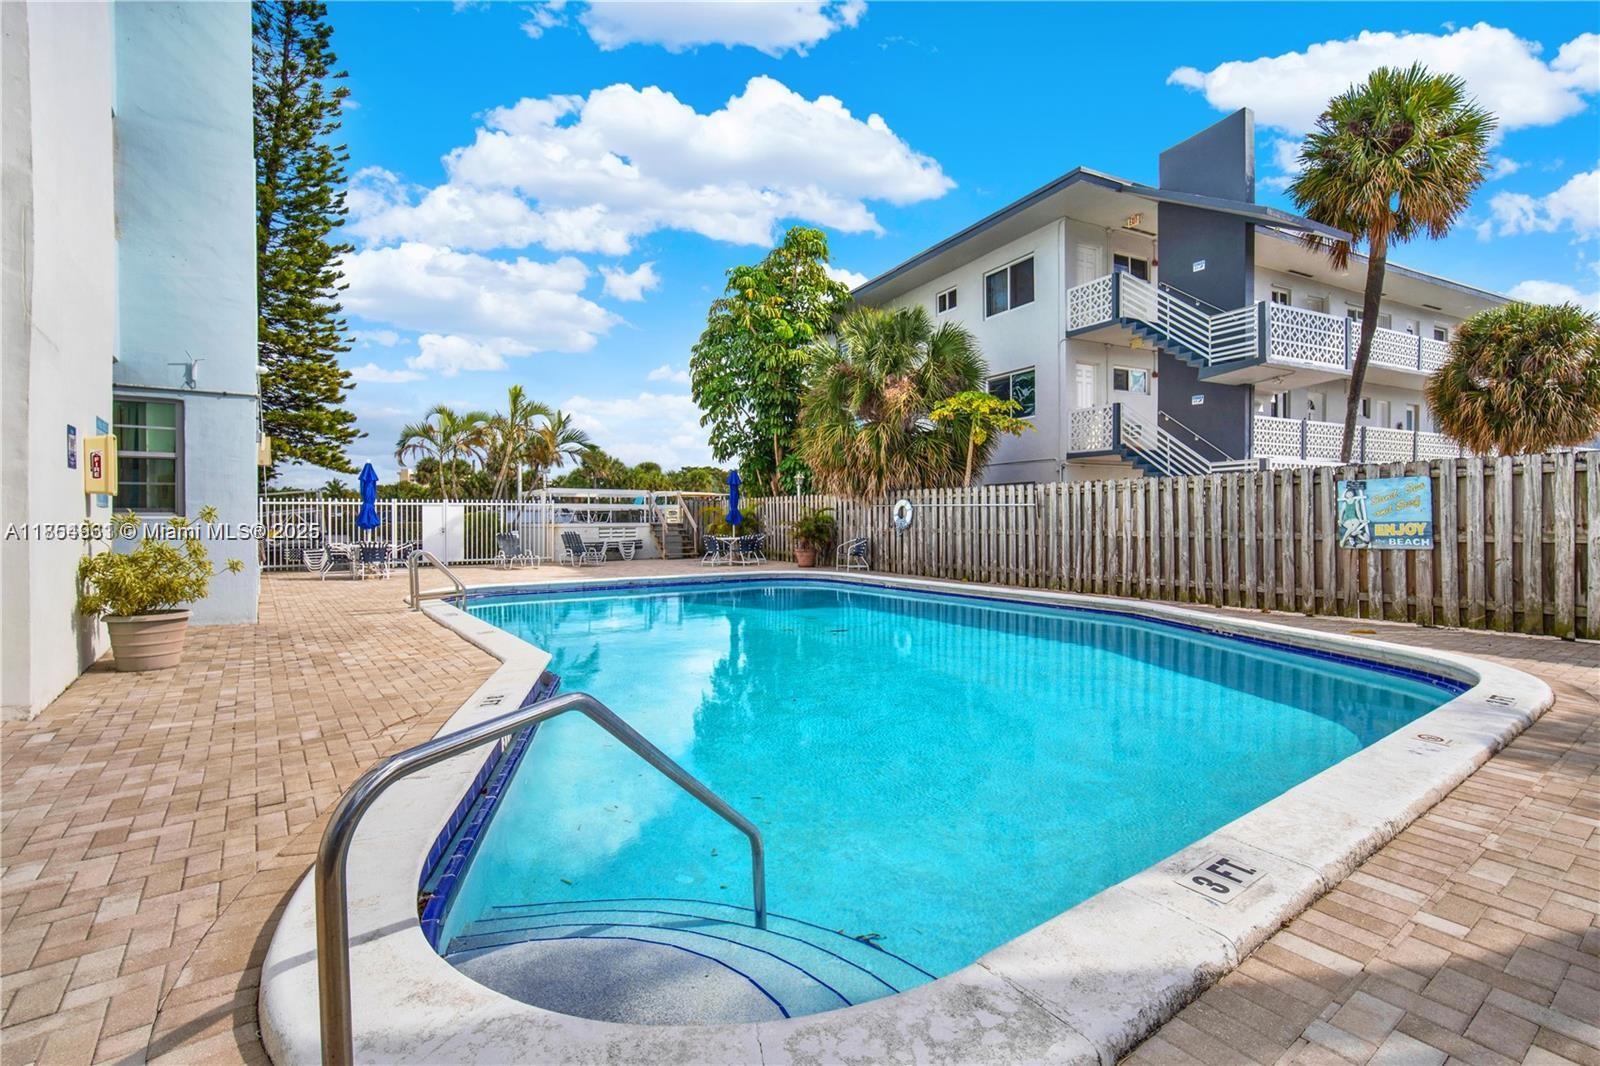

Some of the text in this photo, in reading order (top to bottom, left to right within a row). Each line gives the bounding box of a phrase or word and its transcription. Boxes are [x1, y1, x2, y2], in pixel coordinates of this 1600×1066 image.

[1374, 522, 1427, 536] ENJOY
[1388, 538, 1430, 546] BEACH
[1191, 876, 1230, 894] 3
